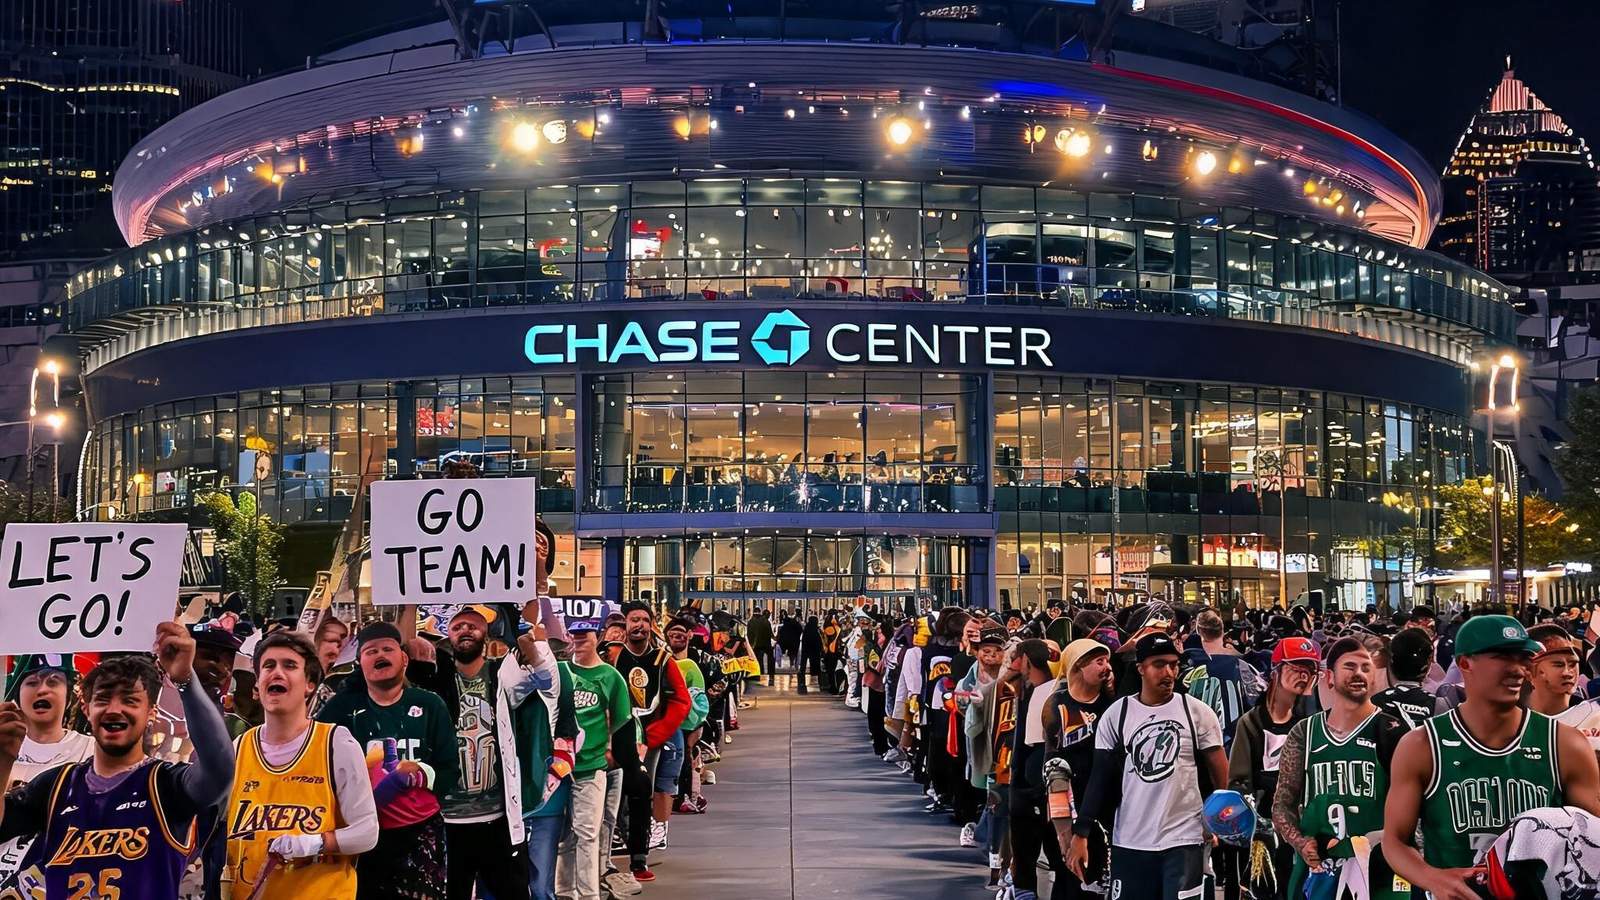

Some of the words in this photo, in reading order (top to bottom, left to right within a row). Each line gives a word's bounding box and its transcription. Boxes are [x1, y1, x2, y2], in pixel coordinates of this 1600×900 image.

[524, 320, 741, 364] CHASE
[826, 323, 1054, 367] CENTER
[417, 488, 484, 536] GO
[8, 531, 155, 589] LET'S
[384, 543, 526, 596] TEAM!
[38, 589, 131, 640] GO!
[227, 799, 327, 840] LAKERS
[45, 825, 151, 868] LAKERS
